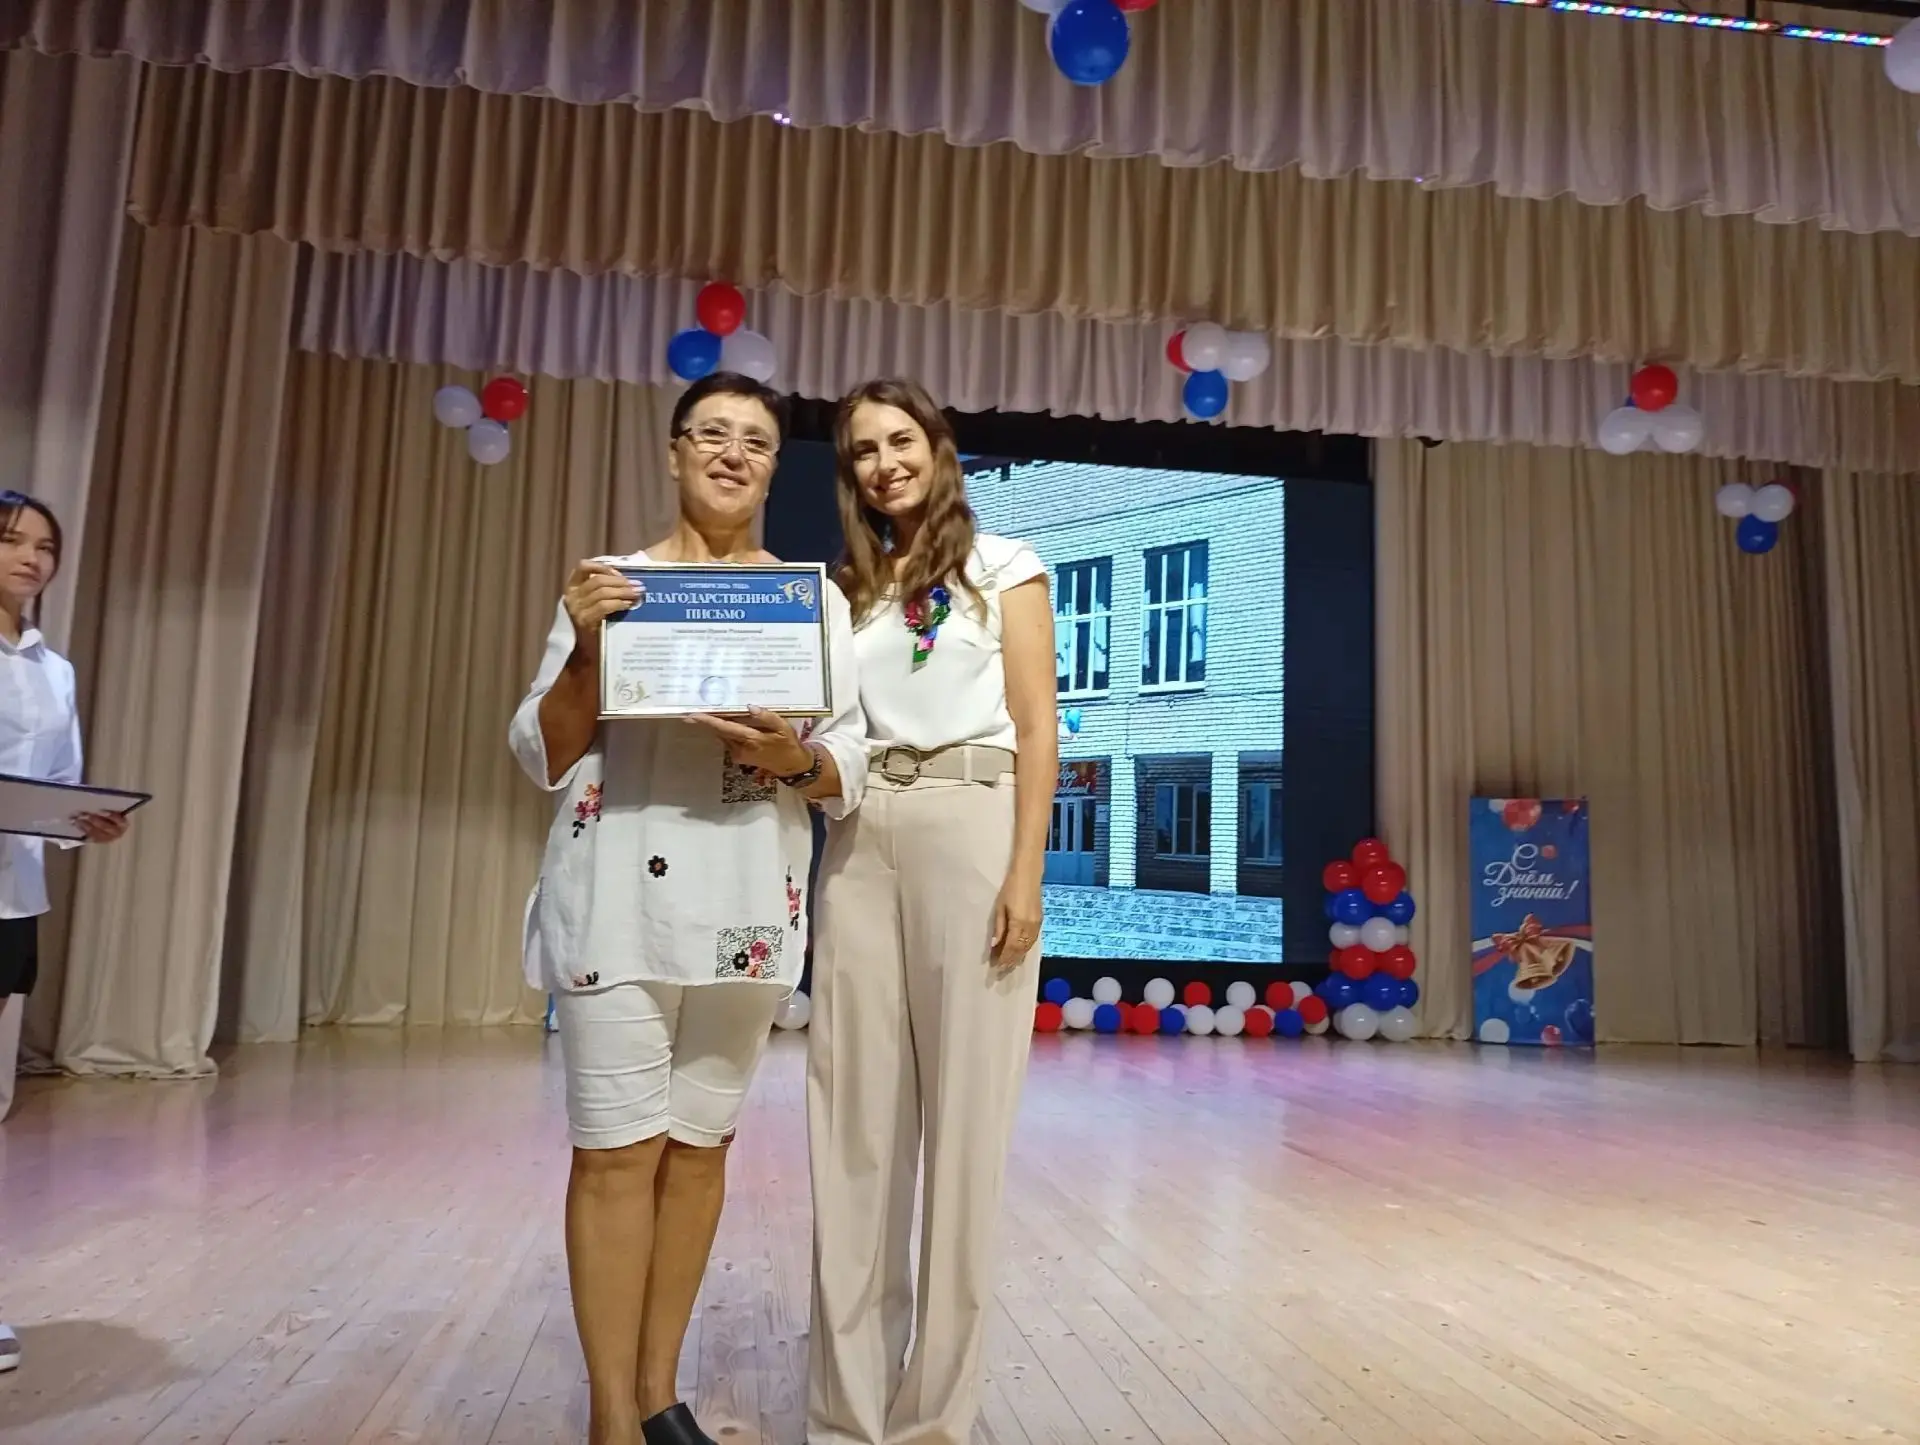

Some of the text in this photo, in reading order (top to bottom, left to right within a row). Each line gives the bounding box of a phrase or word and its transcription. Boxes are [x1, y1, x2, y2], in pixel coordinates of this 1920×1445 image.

[645, 592, 785, 604] БЛАГОДАРСТВЕННОЕ
[685, 608, 746, 620] ПИСЬМО
[1512, 843, 1538, 870] С
[1483, 861, 1554, 886] Днём
[1491, 882, 1579, 907] знаний!
